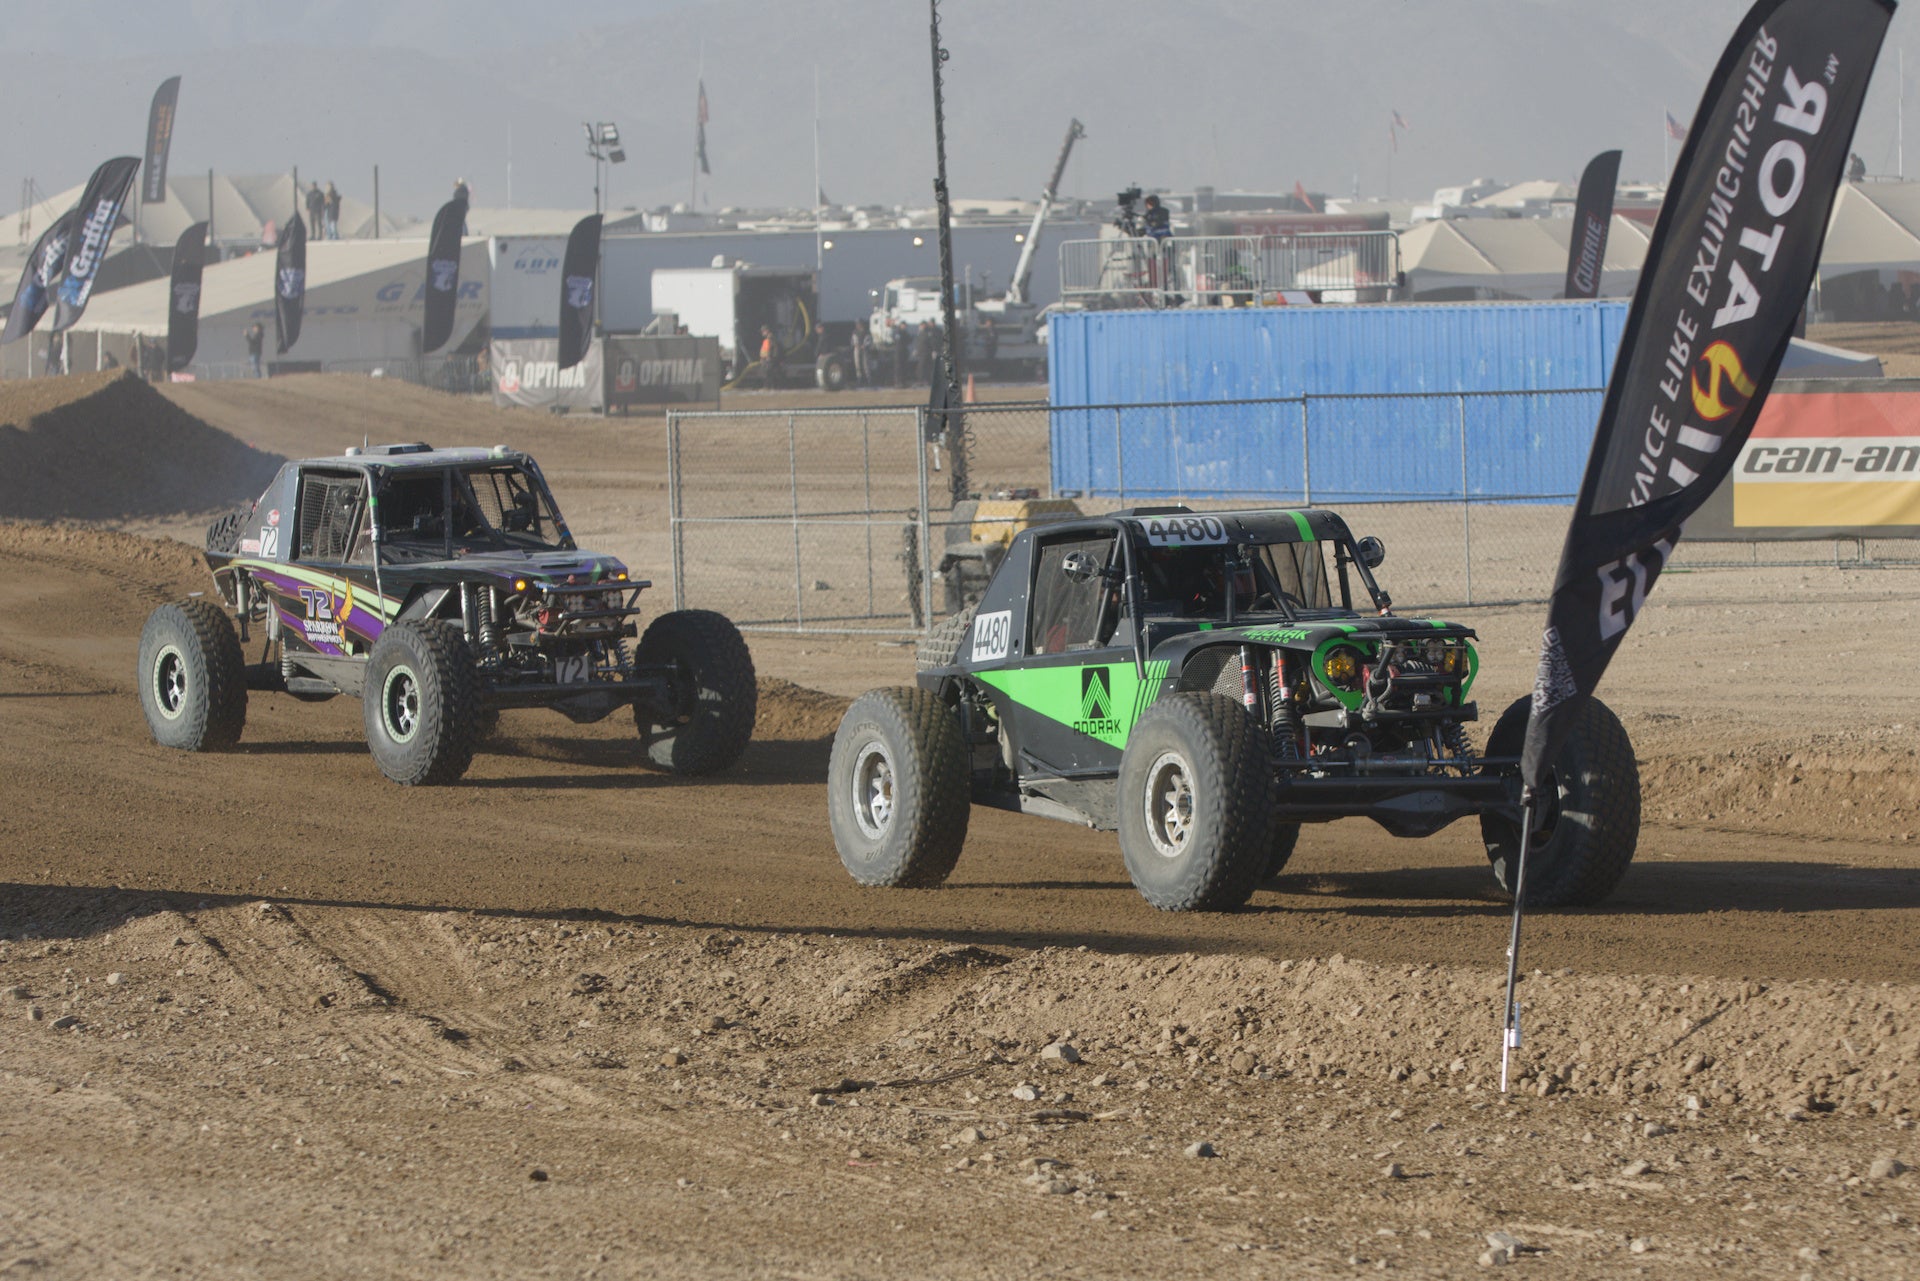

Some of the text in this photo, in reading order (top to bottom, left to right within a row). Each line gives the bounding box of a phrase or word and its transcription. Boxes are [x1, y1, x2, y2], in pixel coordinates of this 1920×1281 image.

[70, 198, 115, 278] Griffin
[1573, 215, 1602, 293] CURRIE
[522, 360, 586, 389] OPTIMA
[639, 358, 704, 386] OPTIMA
[262, 528, 277, 557] 72
[1149, 517, 1222, 542] 4480
[299, 587, 332, 620] 72
[303, 619, 339, 635] SPARROW
[975, 615, 1009, 657] 4480
[557, 657, 585, 682] 72
